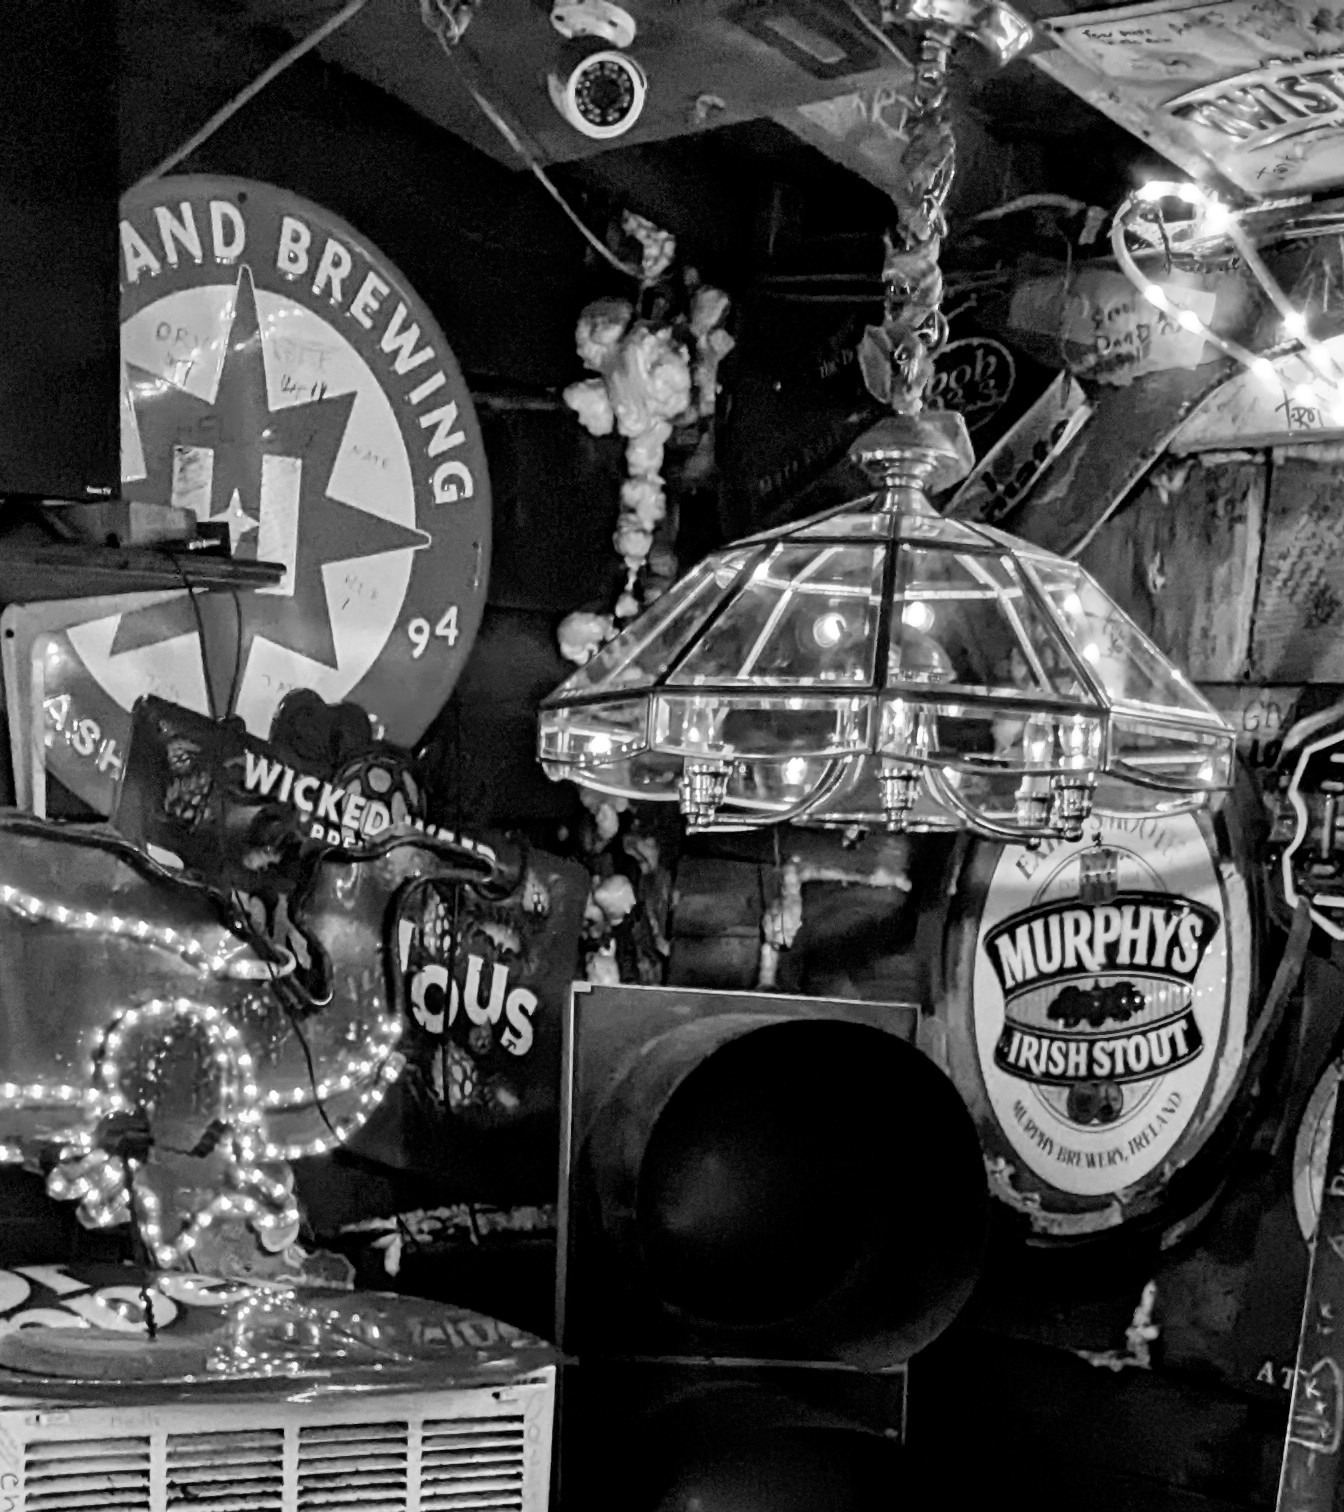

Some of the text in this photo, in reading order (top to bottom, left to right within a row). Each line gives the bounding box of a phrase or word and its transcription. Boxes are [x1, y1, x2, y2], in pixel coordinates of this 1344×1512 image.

[120, 201, 475, 504] AND BREWING
[408, 606, 458, 658] 94
[244, 749, 390, 837] WICKED
[994, 905, 1204, 989] MURPHY'S
[1007, 1021, 1189, 1078] IRISH STOUT
[1012, 1100, 1054, 1158] MURPHY
